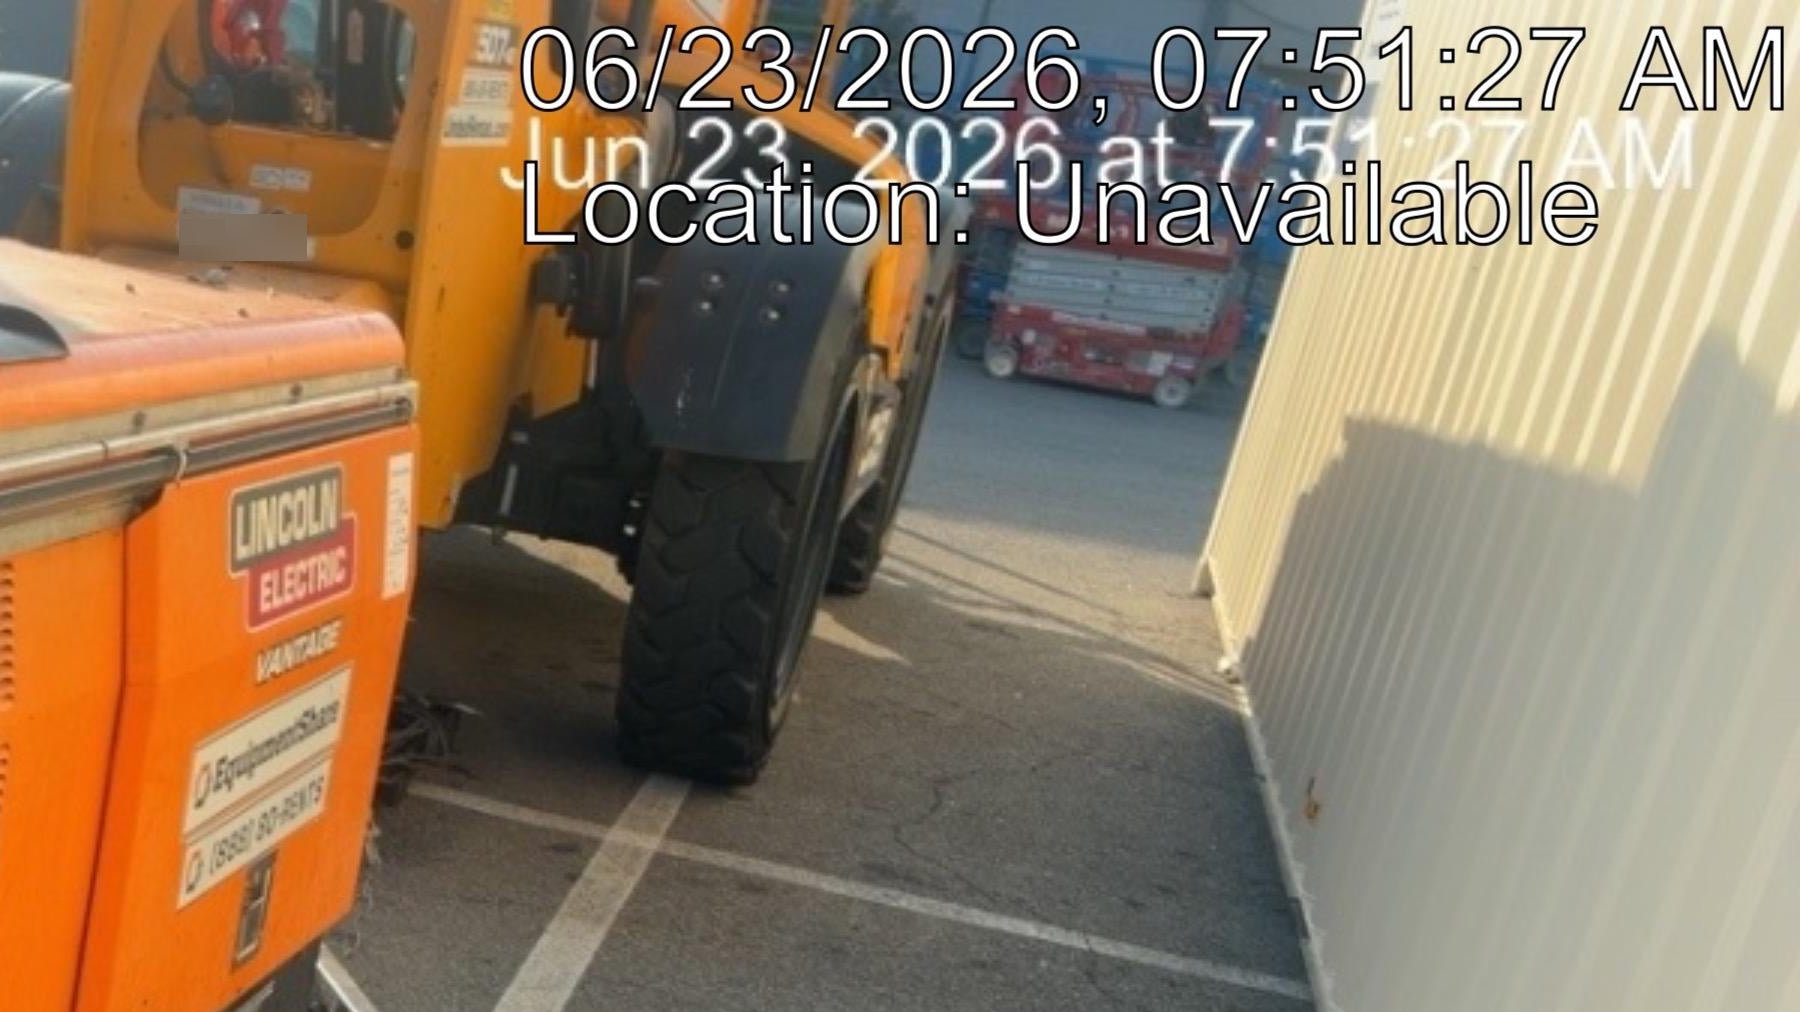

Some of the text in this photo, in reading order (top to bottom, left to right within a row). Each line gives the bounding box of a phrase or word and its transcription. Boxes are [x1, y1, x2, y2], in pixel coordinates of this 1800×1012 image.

[236, 476, 339, 559] LINCOLN
[259, 545, 346, 613] ELECTRIC
[256, 622, 340, 684] VANTAGE
